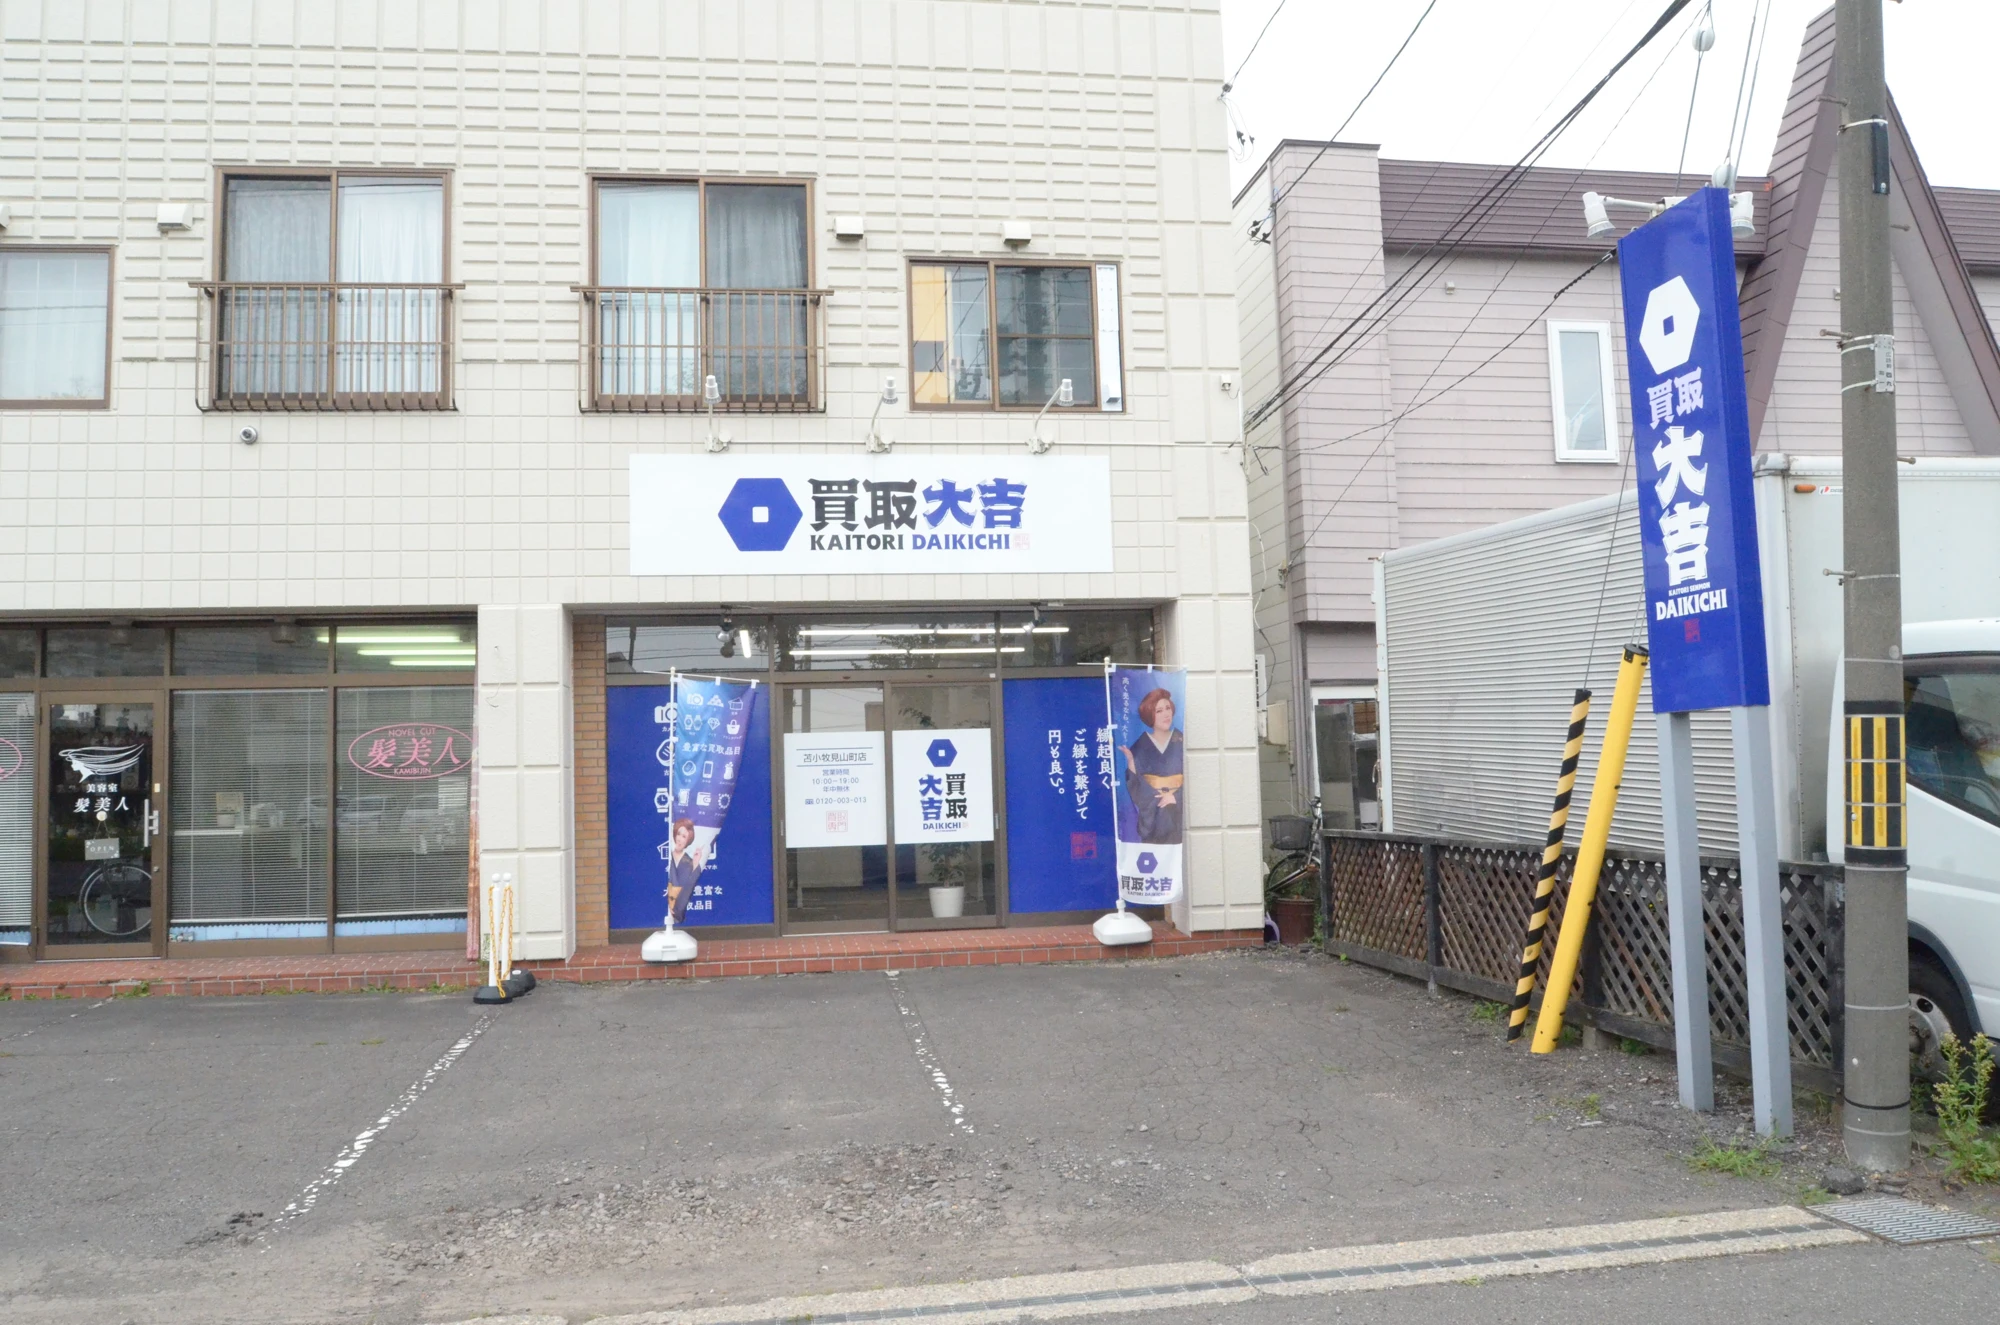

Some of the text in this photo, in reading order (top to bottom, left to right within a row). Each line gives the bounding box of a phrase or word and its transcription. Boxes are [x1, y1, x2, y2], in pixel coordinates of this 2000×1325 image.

[1647, 367, 1704, 430] 買取
[808, 477, 1028, 532] 買取大吉
[1652, 426, 1710, 586] 大吉
[810, 534, 904, 550] KAITORI
[912, 533, 1010, 550] DAIKICHI
[1669, 586, 1690, 597] KAITORI
[1655, 588, 1728, 621] DAIKICHI
[388, 729, 416, 737] NOVEL
[364, 736, 461, 769] 髪美人
[803, 752, 867, 763] 苫小牧見山町店
[1048, 729, 1065, 795] 円も良い。
[394, 767, 432, 775] KAMIBIJIN
[1072, 728, 1090, 820] ご縁を繋げて
[86, 783, 118, 793] 美容室
[816, 796, 867, 805] 0120-003-013
[919, 774, 943, 821] 大吉
[945, 773, 968, 819] 買取
[73, 796, 130, 813] 髪美人
[922, 822, 961, 830] DAIKICHI
